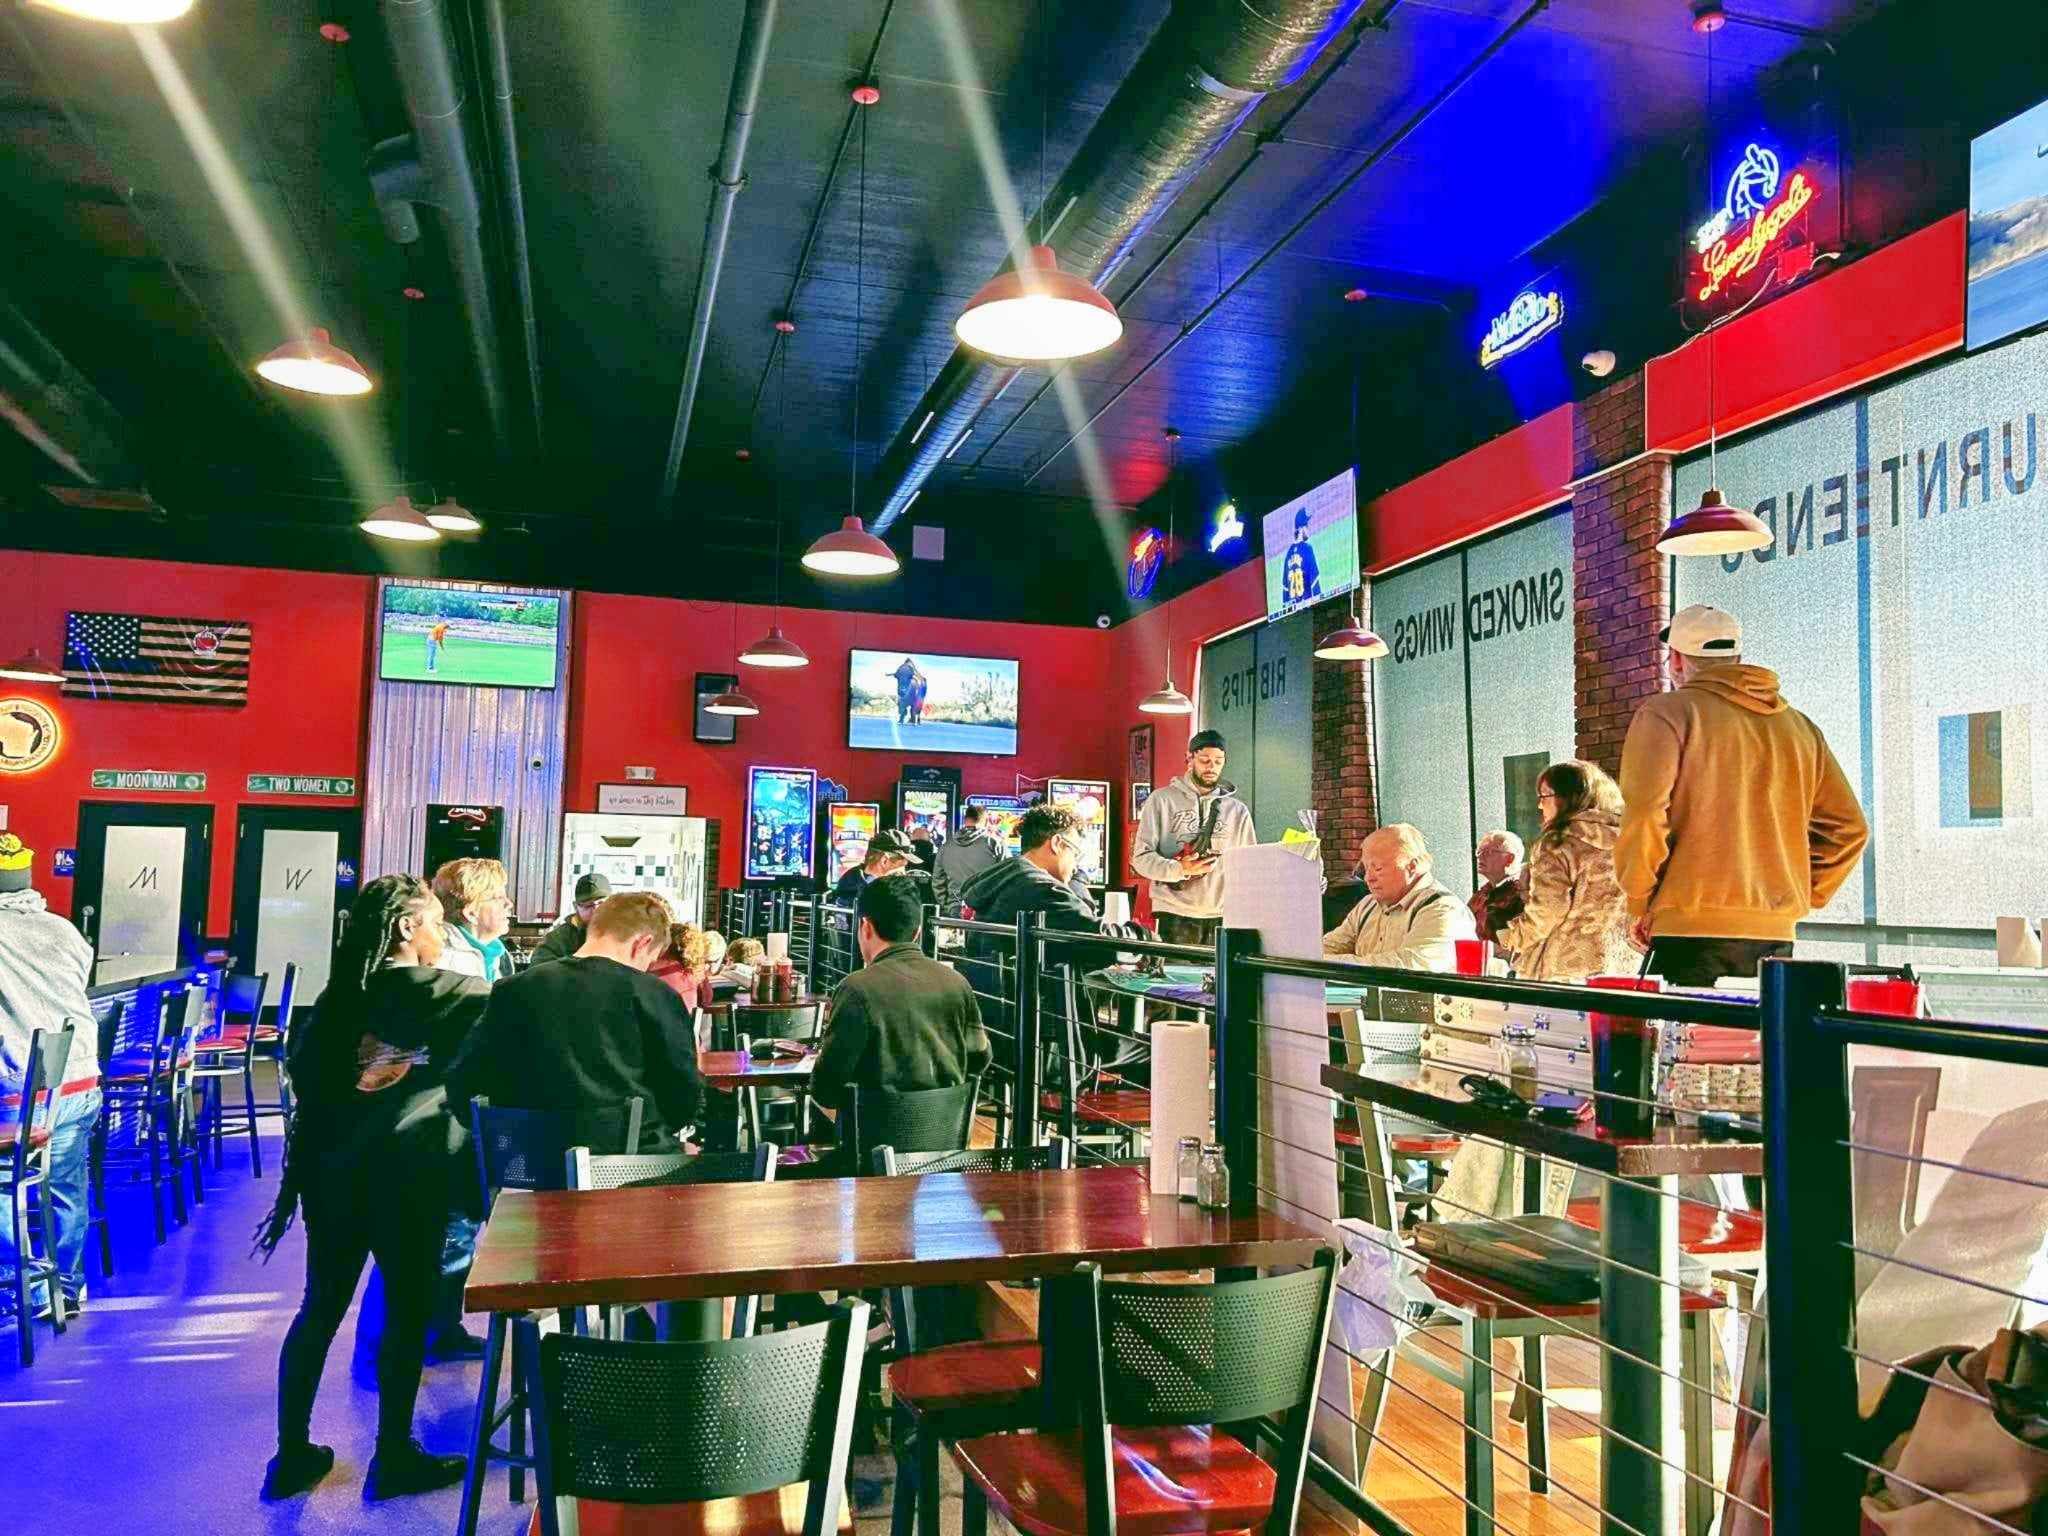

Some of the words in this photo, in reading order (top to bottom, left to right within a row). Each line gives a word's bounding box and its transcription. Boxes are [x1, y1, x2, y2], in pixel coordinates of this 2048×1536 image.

[117, 773, 149, 788] MOON
[152, 774, 177, 789] MAN
[269, 777, 291, 792] TWO
[293, 778, 330, 793] WOMEN
[129, 866, 157, 890] M
[285, 867, 313, 890] W
